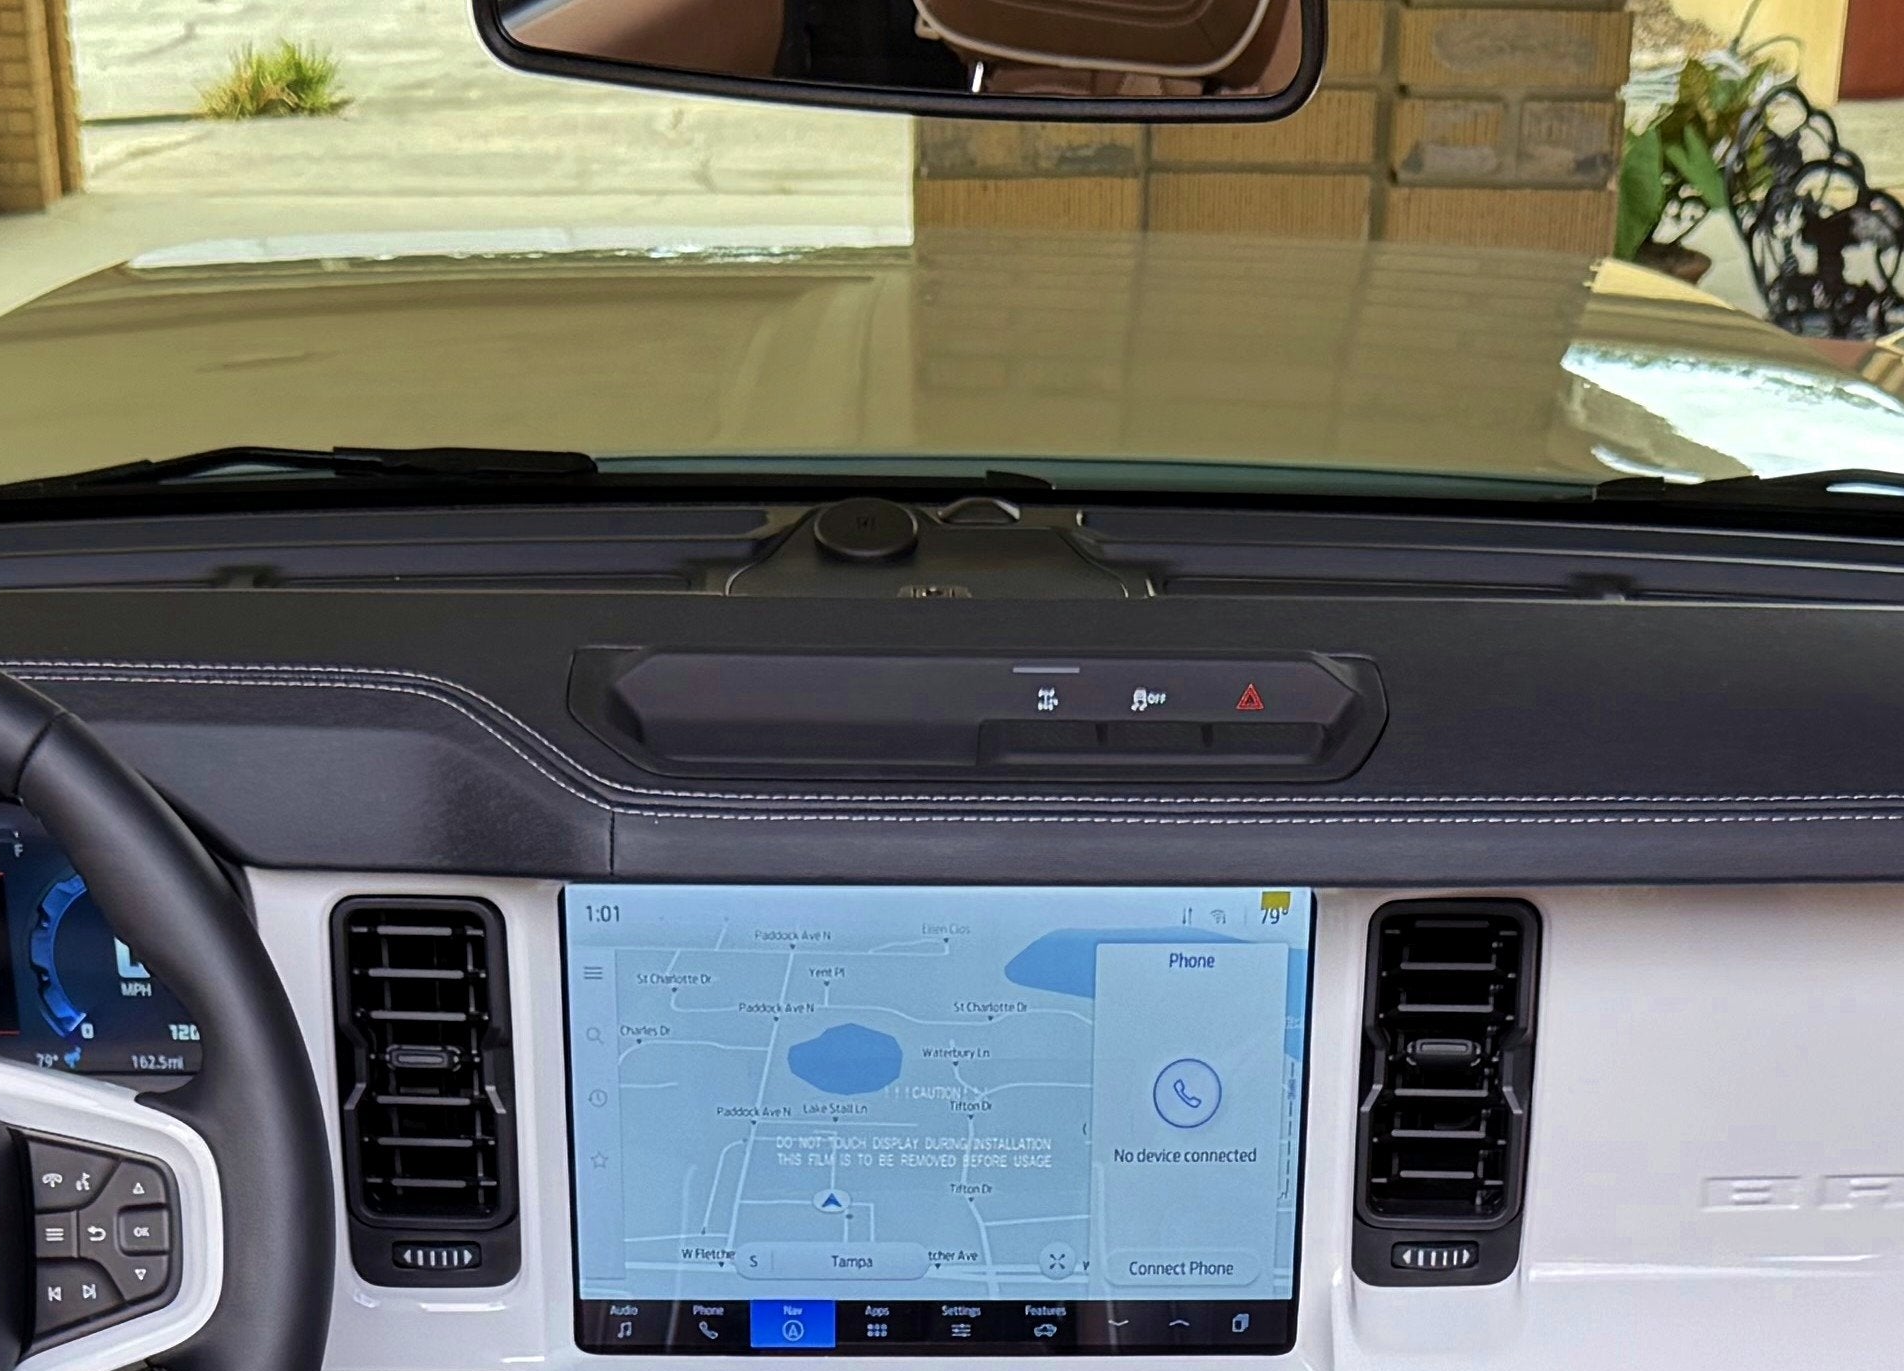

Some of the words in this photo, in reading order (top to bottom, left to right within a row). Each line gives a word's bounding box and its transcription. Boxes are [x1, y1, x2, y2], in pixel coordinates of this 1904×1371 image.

[14, 844, 23, 857] F
[585, 904, 621, 923] 1:01
[755, 930, 799, 941] Paddock
[801, 930, 821, 941] Ave
[822, 930, 832, 941] N
[1169, 952, 1215, 968] Phone
[637, 974, 648, 985] St
[650, 974, 699, 985] Charlotte
[700, 974, 712, 985] Dr
[121, 982, 152, 997] MPH
[738, 1002, 782, 1014] Paddock
[784, 1002, 805, 1014] Ave
[806, 1003, 816, 1014] N
[954, 1002, 965, 1013] St
[967, 1002, 1015, 1013] Charlotte
[1016, 1002, 1028, 1013] Dr
[81, 1023, 94, 1039] 0
[620, 1024, 660, 1036] Charles
[661, 1024, 671, 1036] Dr
[922, 1047, 975, 1060] Waterbury
[976, 1047, 991, 1058] Ln
[717, 1107, 761, 1118] Paddock
[762, 1106, 781, 1118] Ave
[782, 1107, 791, 1117] N
[803, 1104, 827, 1115] Lake
[854, 1104, 868, 1115] Ln
[979, 1101, 992, 1112] Dr
[776, 1137, 793, 1150] DO
[799, 1137, 821, 1150] NOT
[830, 1137, 866, 1150] TOUCH
[873, 1137, 919, 1150] DISPLAY
[926, 1137, 967, 1150] DURING
[973, 1137, 1052, 1150] INSTALLATION
[778, 1154, 801, 1167] THIS
[808, 1154, 834, 1167] FILM
[841, 1154, 852, 1167] IS
[858, 1154, 873, 1167] TO
[879, 1154, 894, 1167] BE
[900, 1154, 956, 1167] REMOVED
[963, 1154, 1007, 1167] BEFORE
[1014, 1154, 1052, 1168] USAGE
[1114, 1149, 1134, 1163] No
[1136, 1149, 1182, 1163] device
[1184, 1149, 1257, 1163] connected
[980, 1184, 992, 1194] Dr
[133, 1226, 150, 1238] OK
[682, 1248, 694, 1259] W
[958, 1251, 978, 1262] Ave
[750, 1256, 758, 1267] S
[832, 1256, 873, 1269] Tampa
[1129, 1261, 1188, 1275] Connect
[1190, 1261, 1234, 1275] Phone
[610, 1306, 638, 1317] Audio
[693, 1306, 724, 1317] Phone
[784, 1306, 803, 1316] Nav
[865, 1306, 890, 1318] Apps
[942, 1305, 981, 1318] Settings
[1025, 1306, 1067, 1317] Features
